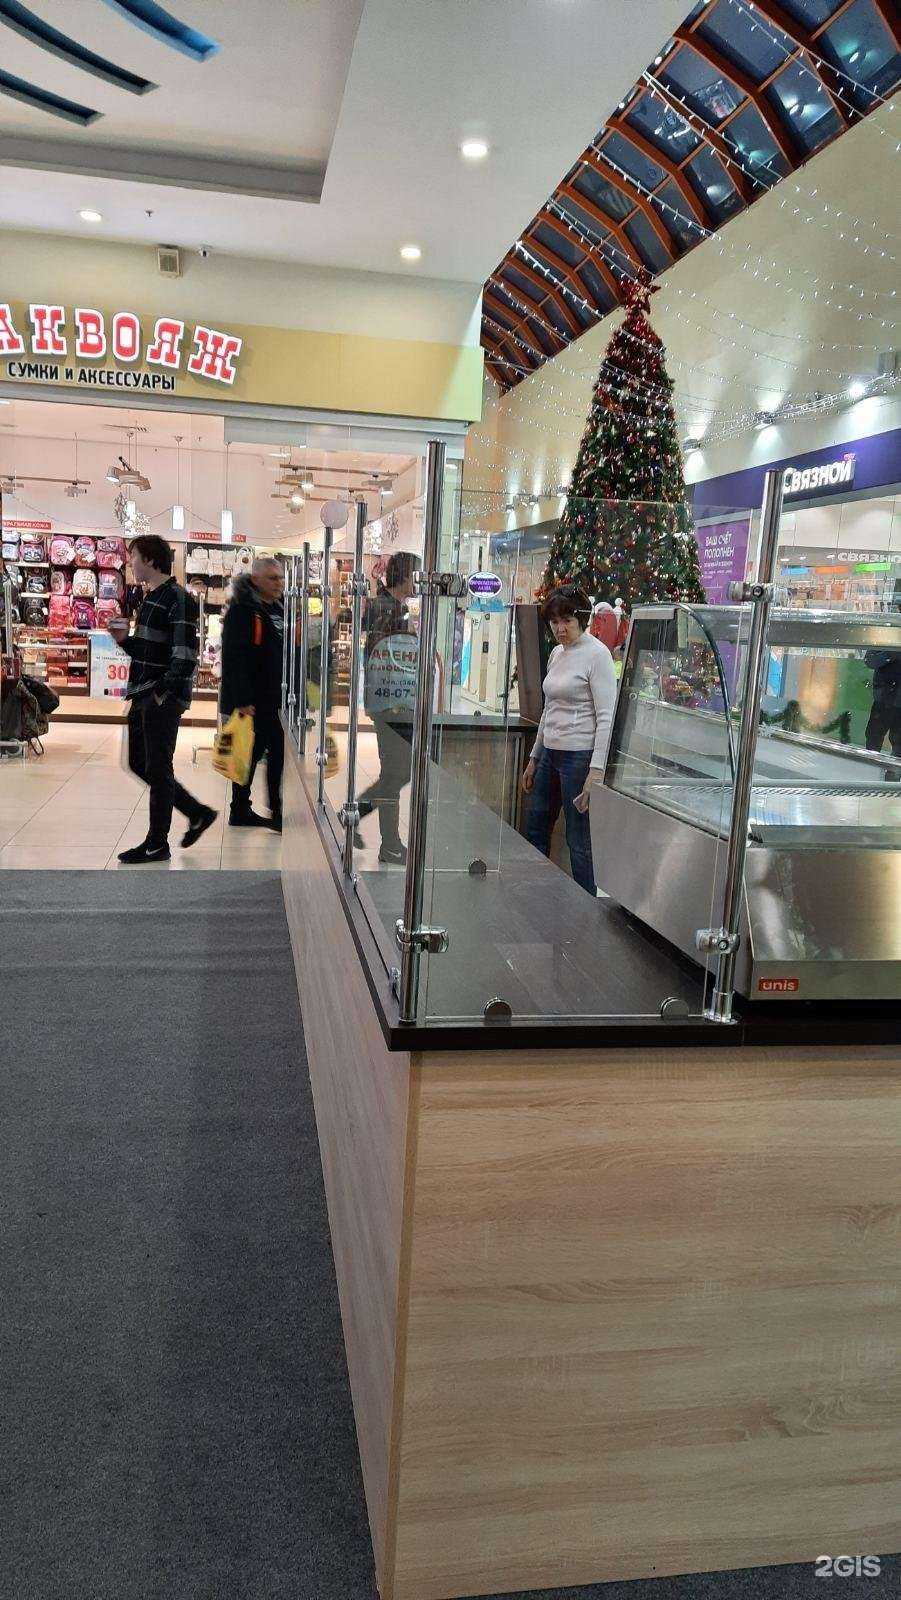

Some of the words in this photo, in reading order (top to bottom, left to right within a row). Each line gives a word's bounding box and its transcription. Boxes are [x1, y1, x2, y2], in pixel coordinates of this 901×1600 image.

[8, 362, 59, 380] СУМКИ
[78, 371, 175, 390] АКСЕССУАРЫ
[762, 980, 796, 991] unis
